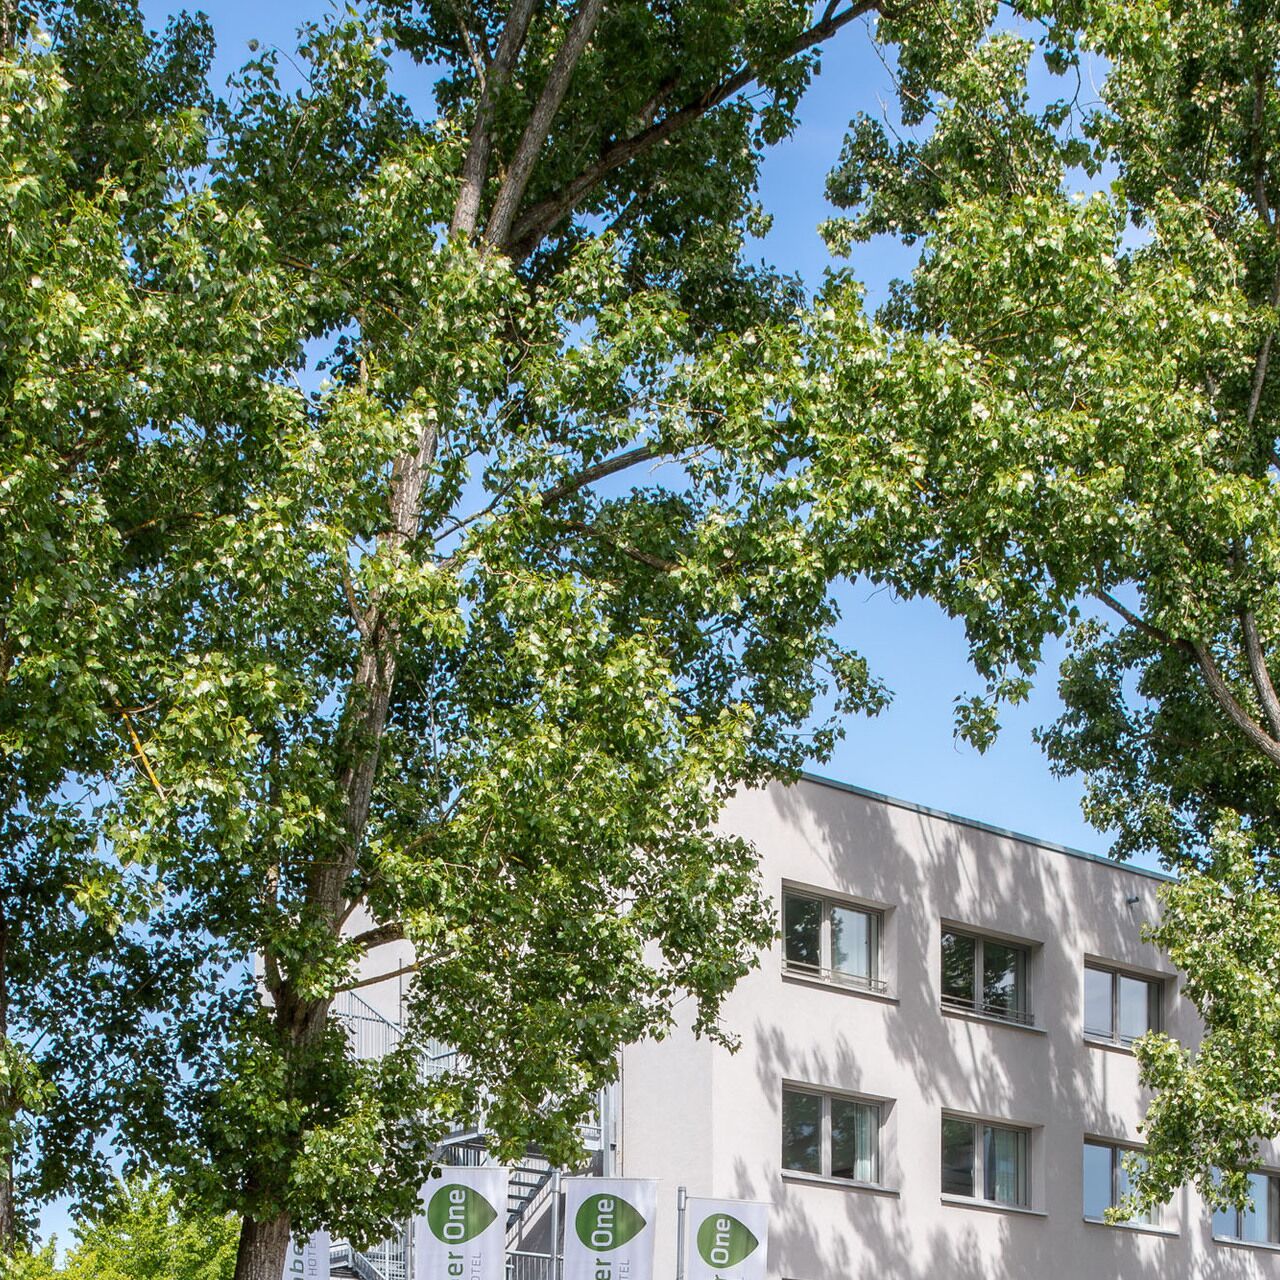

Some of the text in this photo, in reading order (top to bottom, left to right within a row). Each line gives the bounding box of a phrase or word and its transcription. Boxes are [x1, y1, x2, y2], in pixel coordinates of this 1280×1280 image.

[443, 1189, 466, 1240] One
[591, 1198, 615, 1247] One
[710, 1218, 731, 1265] One
